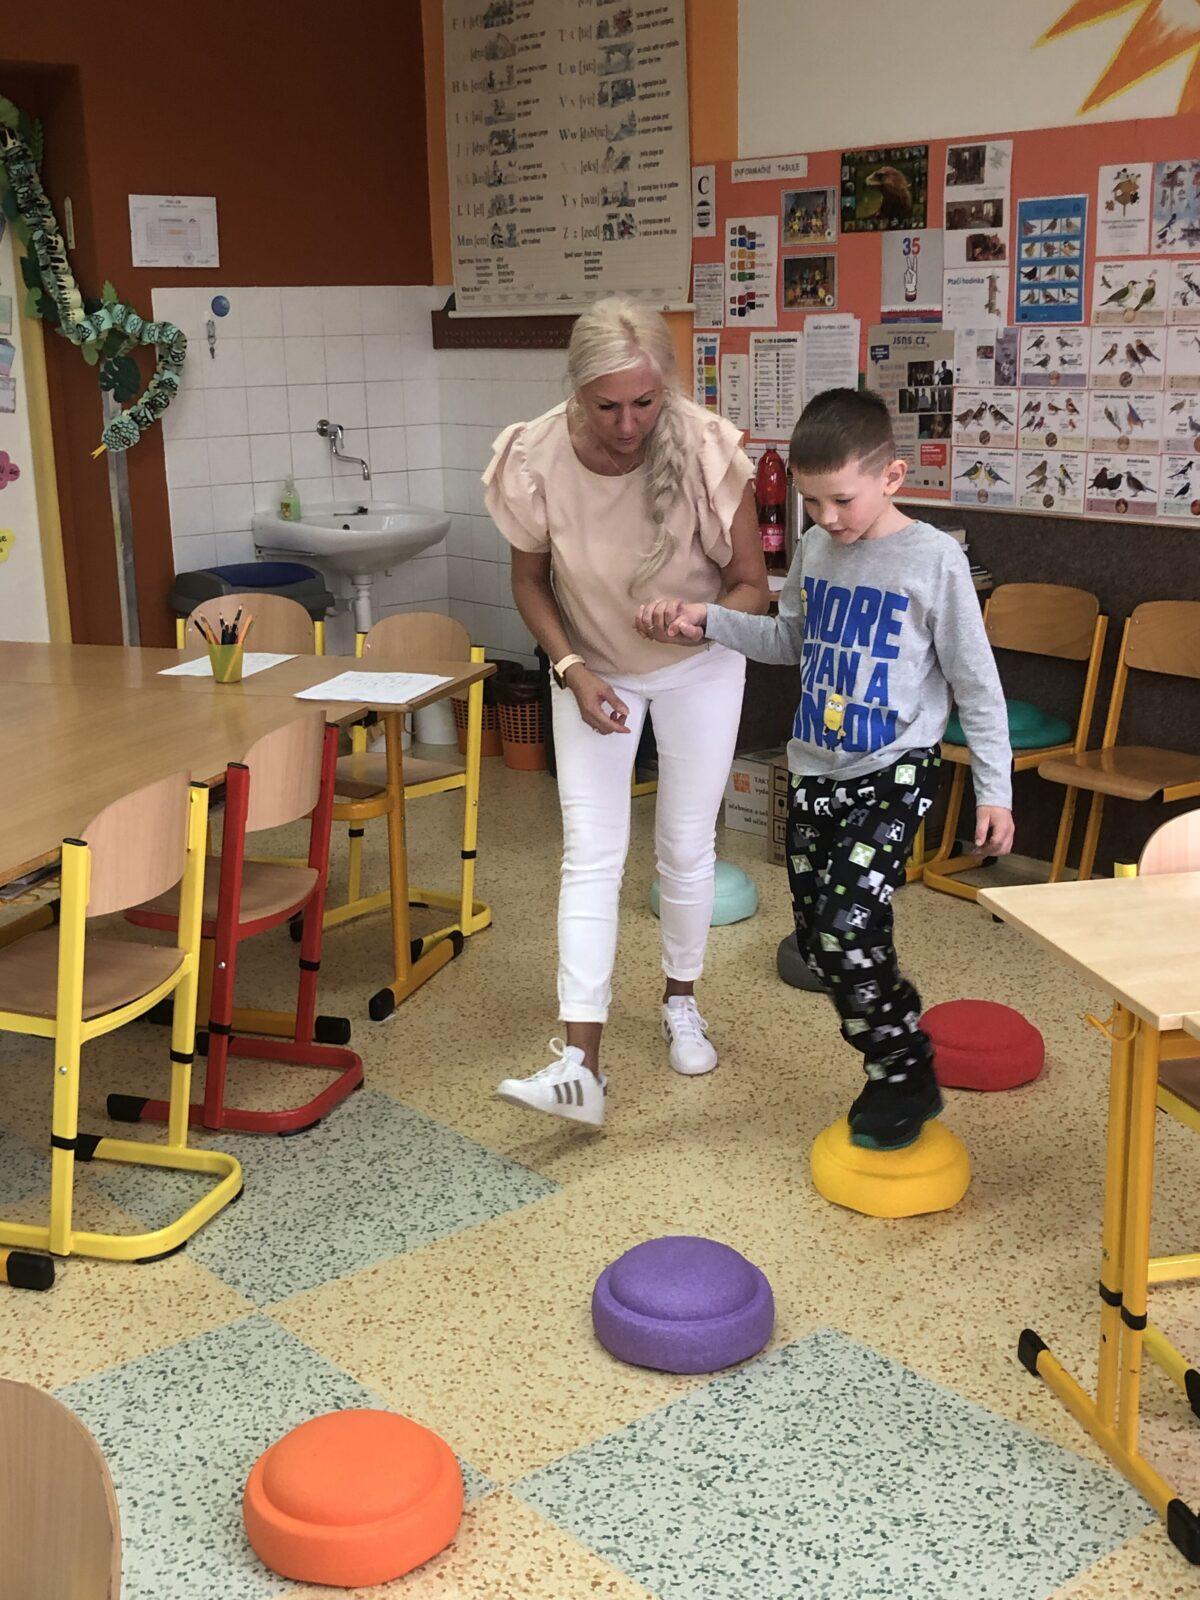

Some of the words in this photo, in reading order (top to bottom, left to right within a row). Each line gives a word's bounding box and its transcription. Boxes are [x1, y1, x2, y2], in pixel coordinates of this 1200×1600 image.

[697, 176, 710, 195] C
[902, 237, 921, 256] 35
[803, 576, 909, 660] MORE
[863, 661, 889, 708] A
